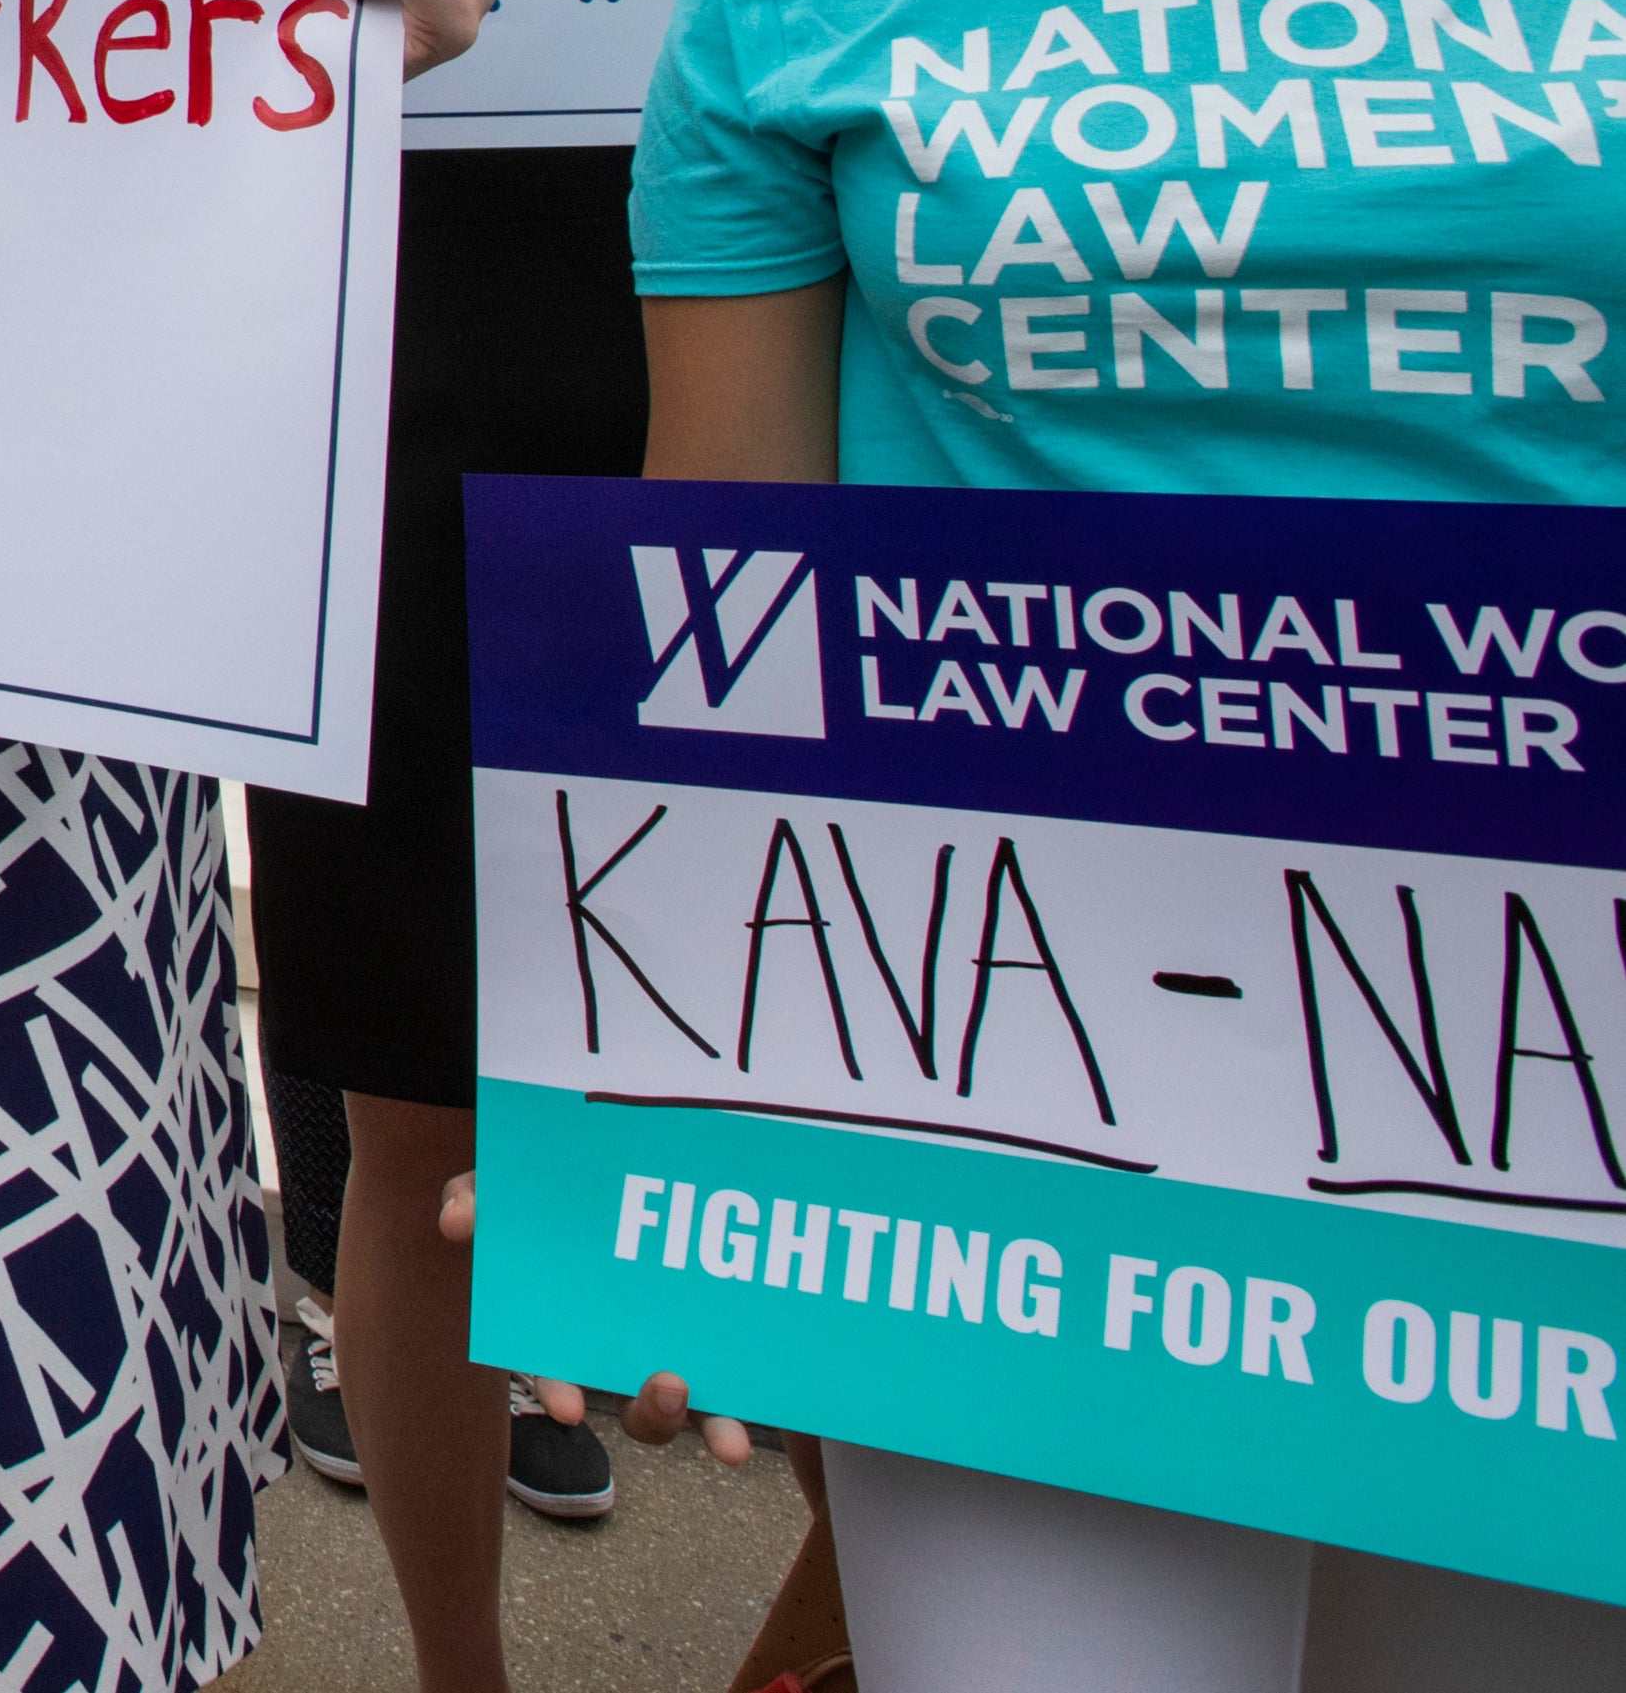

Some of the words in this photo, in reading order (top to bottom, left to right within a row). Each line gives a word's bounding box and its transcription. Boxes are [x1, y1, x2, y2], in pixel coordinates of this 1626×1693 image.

[895, 180, 1269, 286] LAW
[906, 288, 1607, 403] CENTER
[855, 576, 1403, 671] NATIONAL
[862, 656, 1088, 733] LAW
[1123, 674, 1586, 773] CENTER
[612, 1172, 1065, 1339] FIGHTING
[1103, 1251, 1318, 1387] FOR
[1362, 1296, 1619, 1442] OUR
